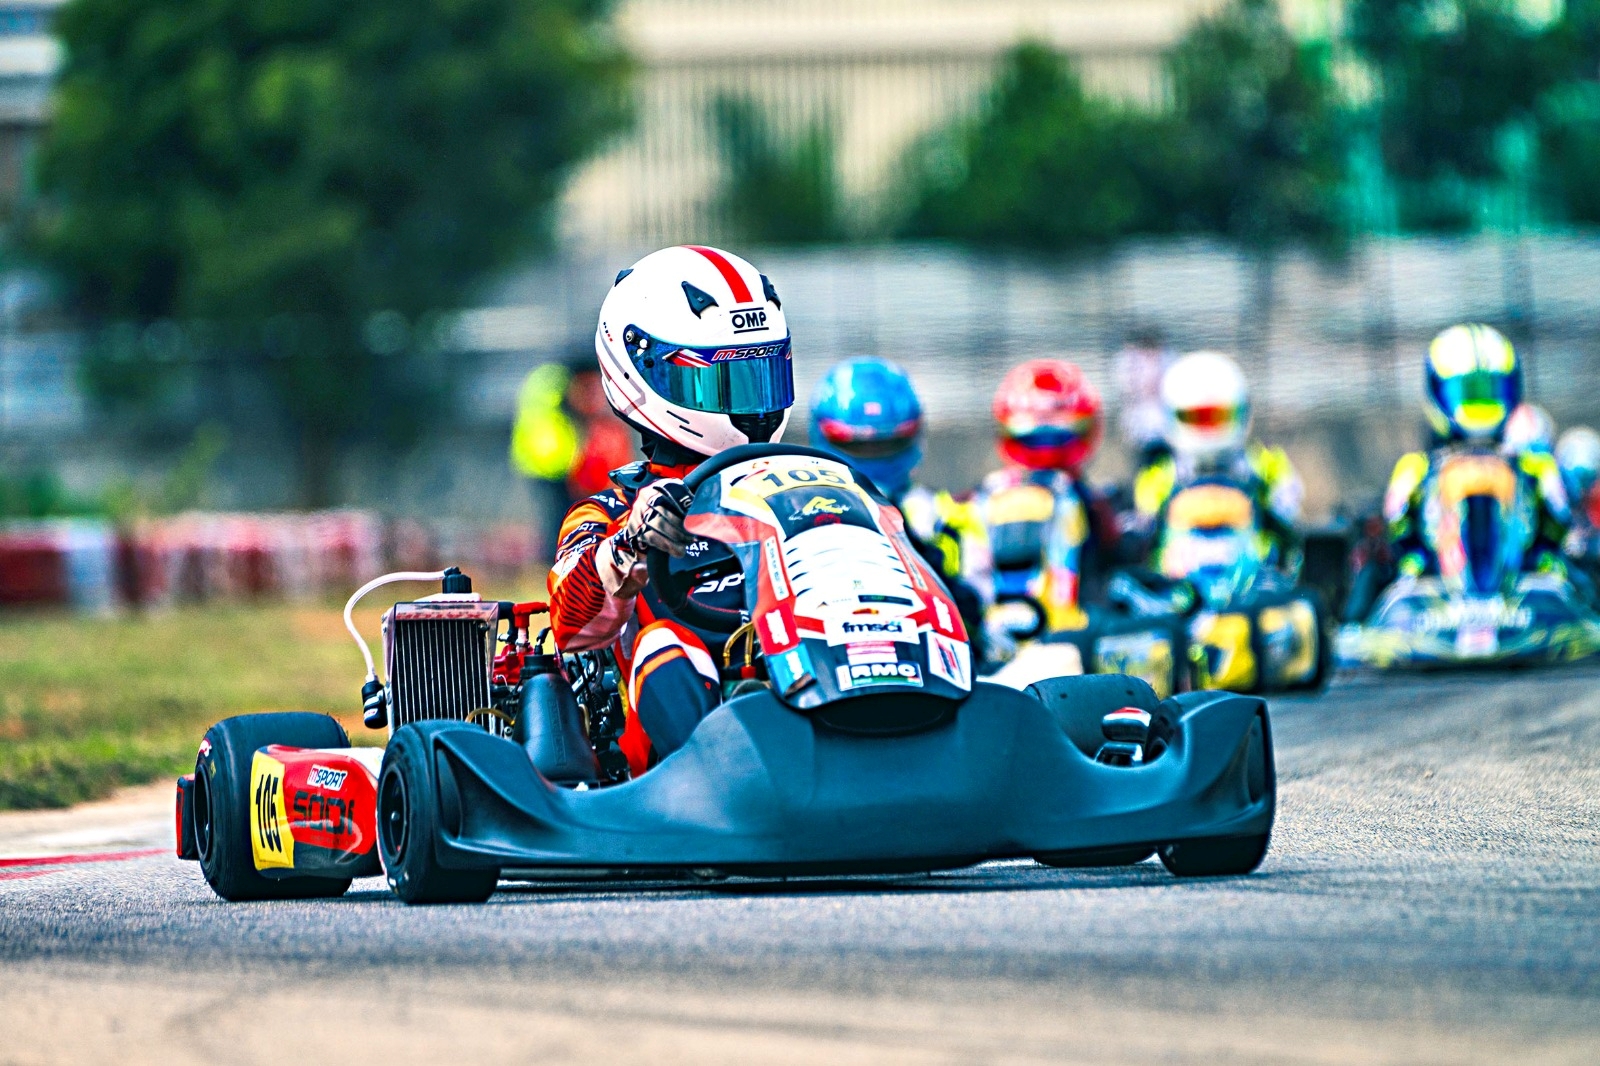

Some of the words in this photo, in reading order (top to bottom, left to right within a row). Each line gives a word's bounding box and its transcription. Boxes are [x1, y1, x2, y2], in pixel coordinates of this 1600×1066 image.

[731, 311, 767, 329] OMP
[762, 469, 847, 487] 105
[255, 773, 282, 853] 105
